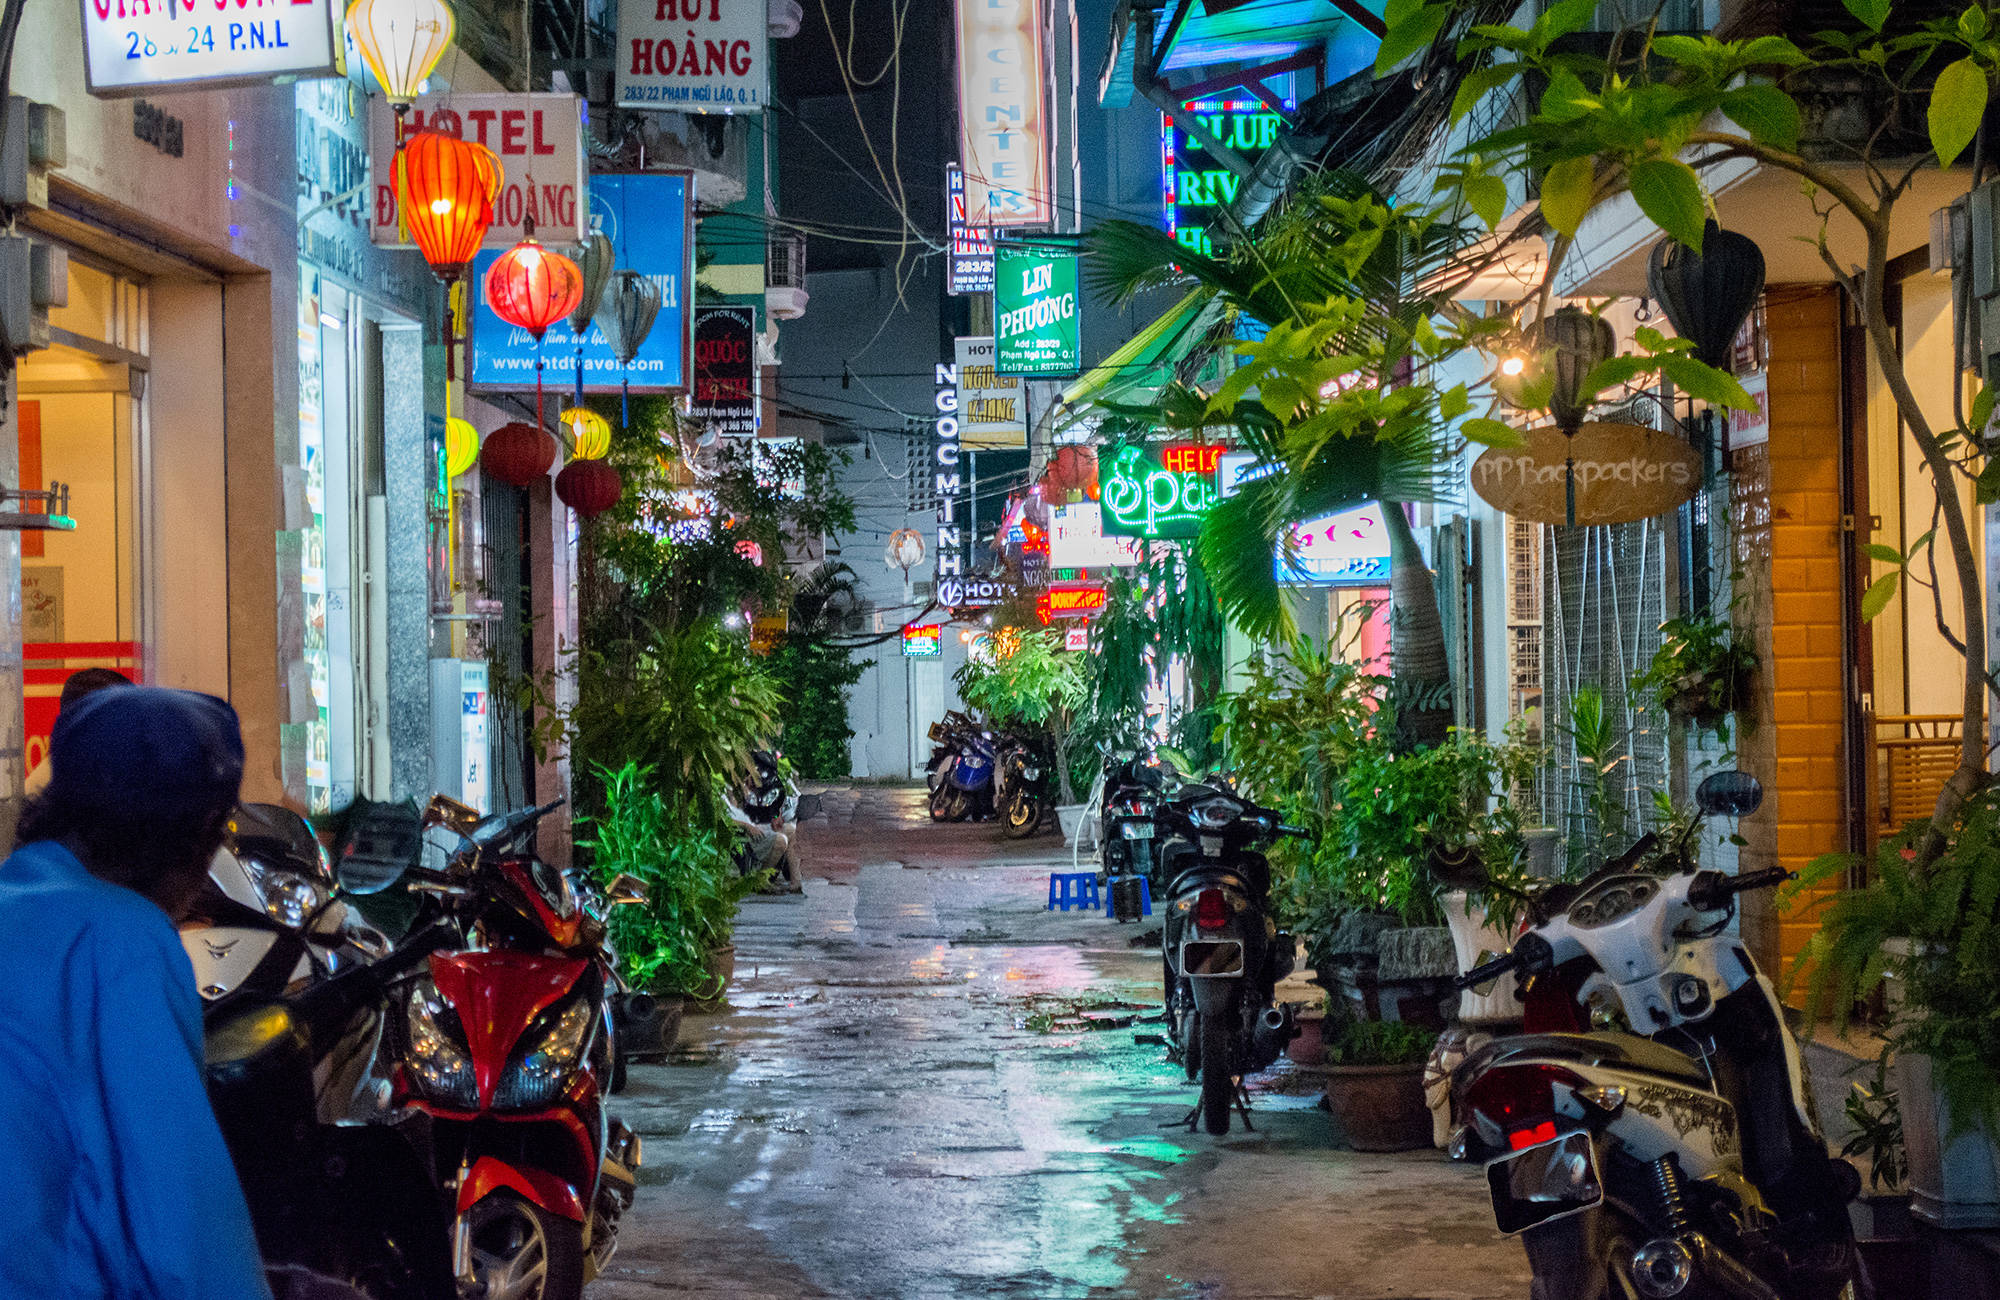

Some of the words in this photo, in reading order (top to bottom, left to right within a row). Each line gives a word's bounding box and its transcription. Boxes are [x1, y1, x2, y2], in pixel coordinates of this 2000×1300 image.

[229, 19, 289, 50] P.N.L
[630, 29, 752, 76] HOÀNG
[1022, 263, 1053, 296] LIN
[968, 346, 994, 355] HOT
[965, 583, 1018, 597] HOT
